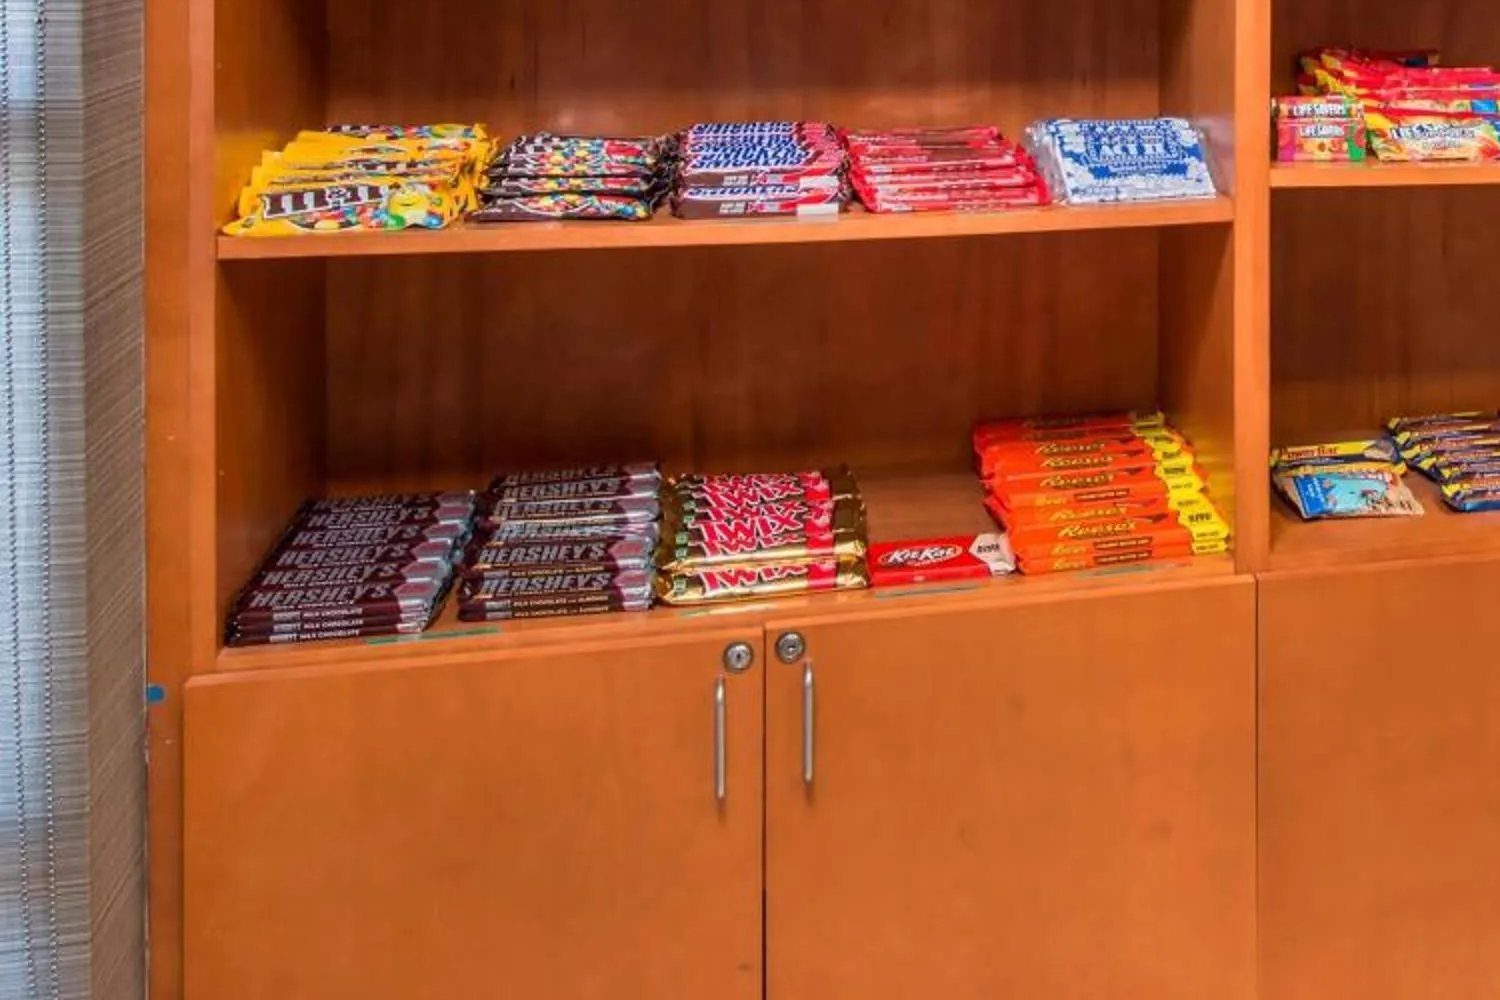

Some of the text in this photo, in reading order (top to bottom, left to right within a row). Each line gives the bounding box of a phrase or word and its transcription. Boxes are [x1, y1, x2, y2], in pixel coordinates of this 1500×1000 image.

[291, 524, 421, 546] HERSHEY'S
[688, 513, 804, 545] TWIX
[276, 543, 410, 568] HERSHEY'S
[477, 542, 606, 564] HERSHEY'S
[262, 562, 399, 587] HERSHEY'S
[479, 572, 612, 594] HERSHEY'S
[249, 583, 391, 608] HERSHEY'S
